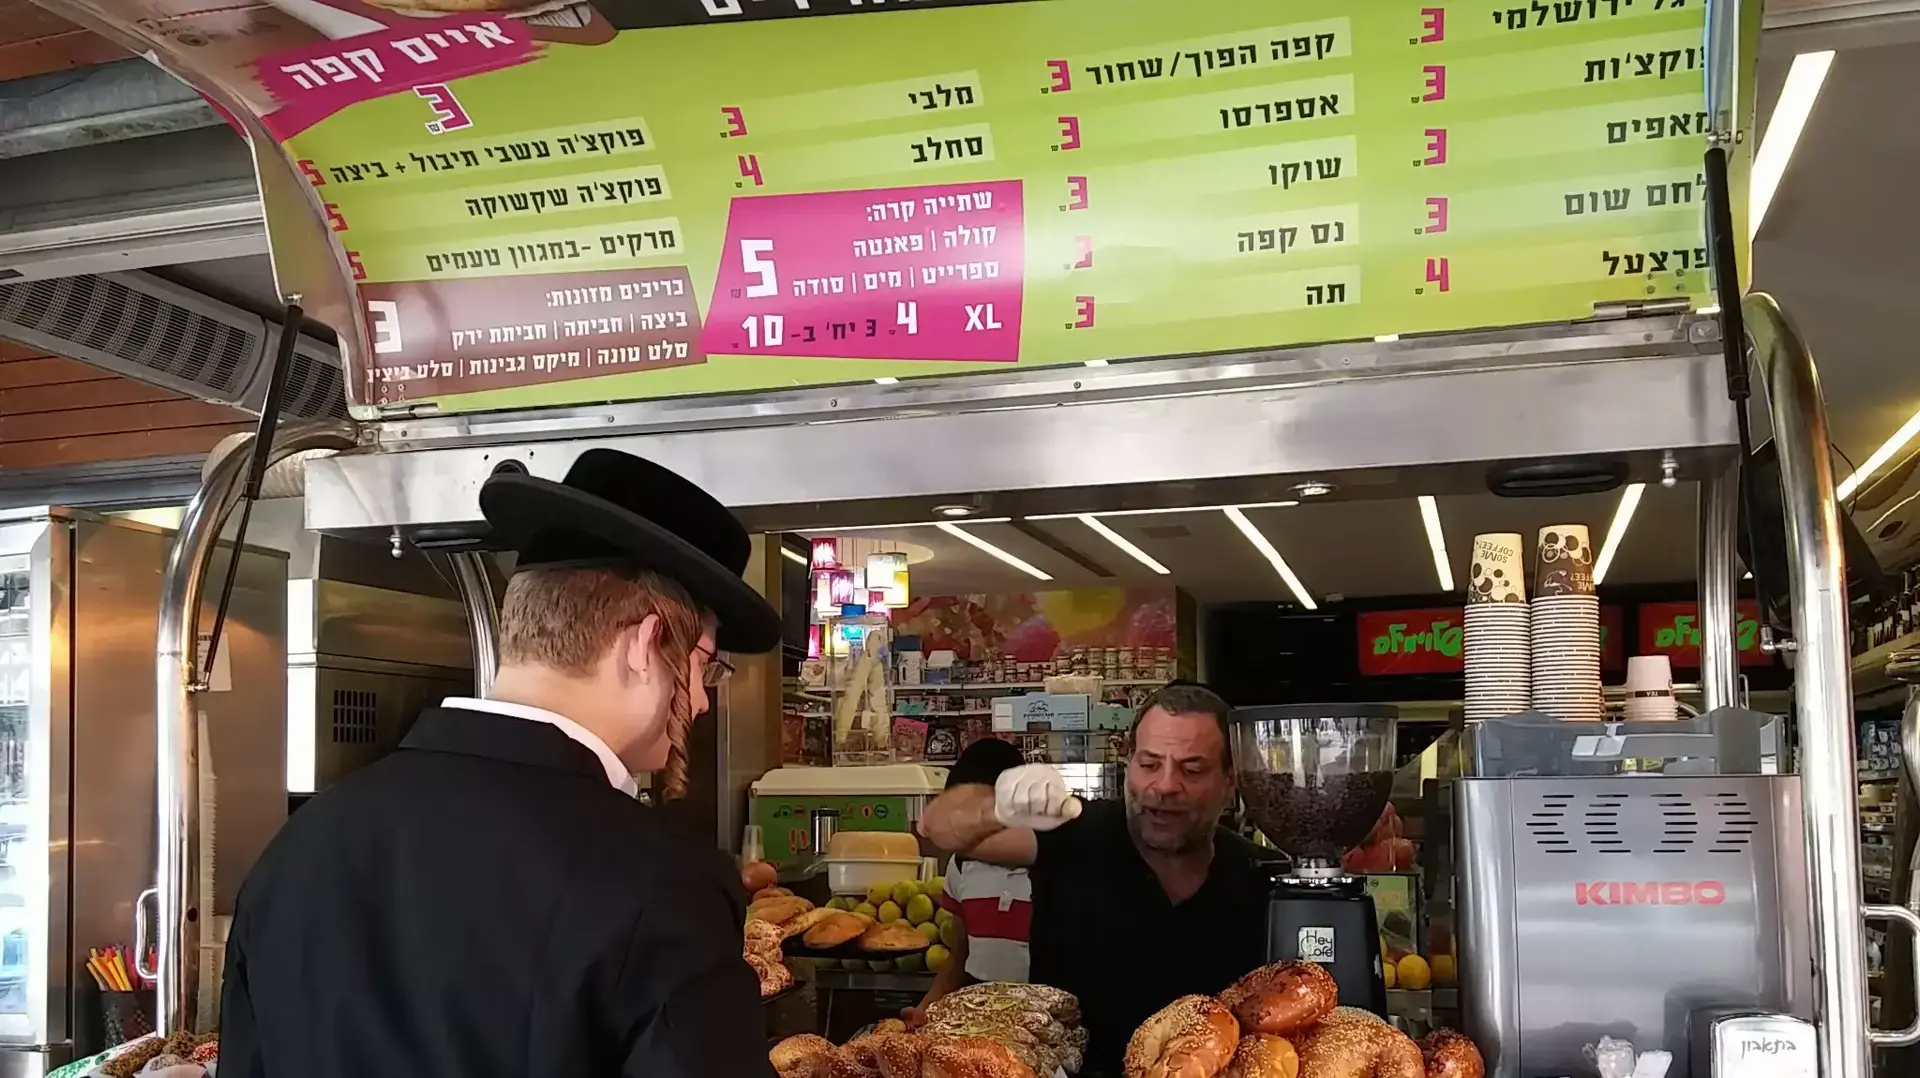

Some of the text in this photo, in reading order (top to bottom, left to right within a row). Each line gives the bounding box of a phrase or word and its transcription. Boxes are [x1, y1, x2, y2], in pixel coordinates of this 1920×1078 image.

[1421, 8, 1445, 43] 3
[280, 20, 516, 91] אייס קפה
[1086, 32, 1335, 85] קפה הפוך/שחור
[1584, 46, 1705, 83] וקצ'ות
[1047, 60, 1071, 92] 3
[1423, 65, 1446, 102] 3
[412, 83, 474, 133] 3
[908, 84, 974, 110] מלבי
[1219, 94, 1340, 129] אספרסו
[721, 107, 747, 137] 3
[1058, 116, 1081, 150] 3
[484, 139, 551, 165] עשבי
[560, 126, 646, 156] פוקצ'ה
[911, 136, 984, 163] סחלב
[1424, 129, 1447, 165] 3
[296, 159, 327, 187] 5
[329, 161, 389, 183] ביצה
[408, 147, 480, 173] תיבול
[737, 154, 764, 186] 4
[1268, 157, 1342, 190] שוקו
[465, 175, 663, 217] פוקצ'ה שקשוקה
[865, 191, 993, 223] שתייה קרה:
[1067, 176, 1089, 210] 3
[1564, 187, 1631, 216] שום
[324, 203, 349, 232] 5
[1425, 197, 1448, 233] 3
[600, 228, 676, 260] מרקים
[853, 225, 997, 258] קולה פאנטה
[1237, 221, 1345, 254] נס קפה
[345, 251, 367, 280] 5
[425, 247, 500, 273] טעמים
[740, 239, 778, 299] 5
[1426, 257, 1449, 292] 4
[1602, 247, 1709, 276] פרצעל
[546, 279, 684, 308] כריכים מזונות:
[792, 260, 999, 298] ספרייט מים סודה
[1306, 283, 1346, 306] תה
[368, 300, 402, 354] 3
[865, 319, 877, 337] 3
[897, 300, 1002, 335] XL 4
[1075, 296, 1095, 328] 3
[452, 311, 688, 351] ביצה חביתה חביתת ירק
[741, 314, 784, 348] 10
[469, 356, 526, 376] גבינות
[532, 351, 580, 373] מיקס
[597, 346, 641, 366] טונה
[648, 339, 688, 361] סלט
[416, 360, 453, 379] סלט
[1575, 880, 1726, 906] KIMBO
[1306, 930, 1333, 951] Hey
[1740, 1037, 1797, 1059] בתאבון
